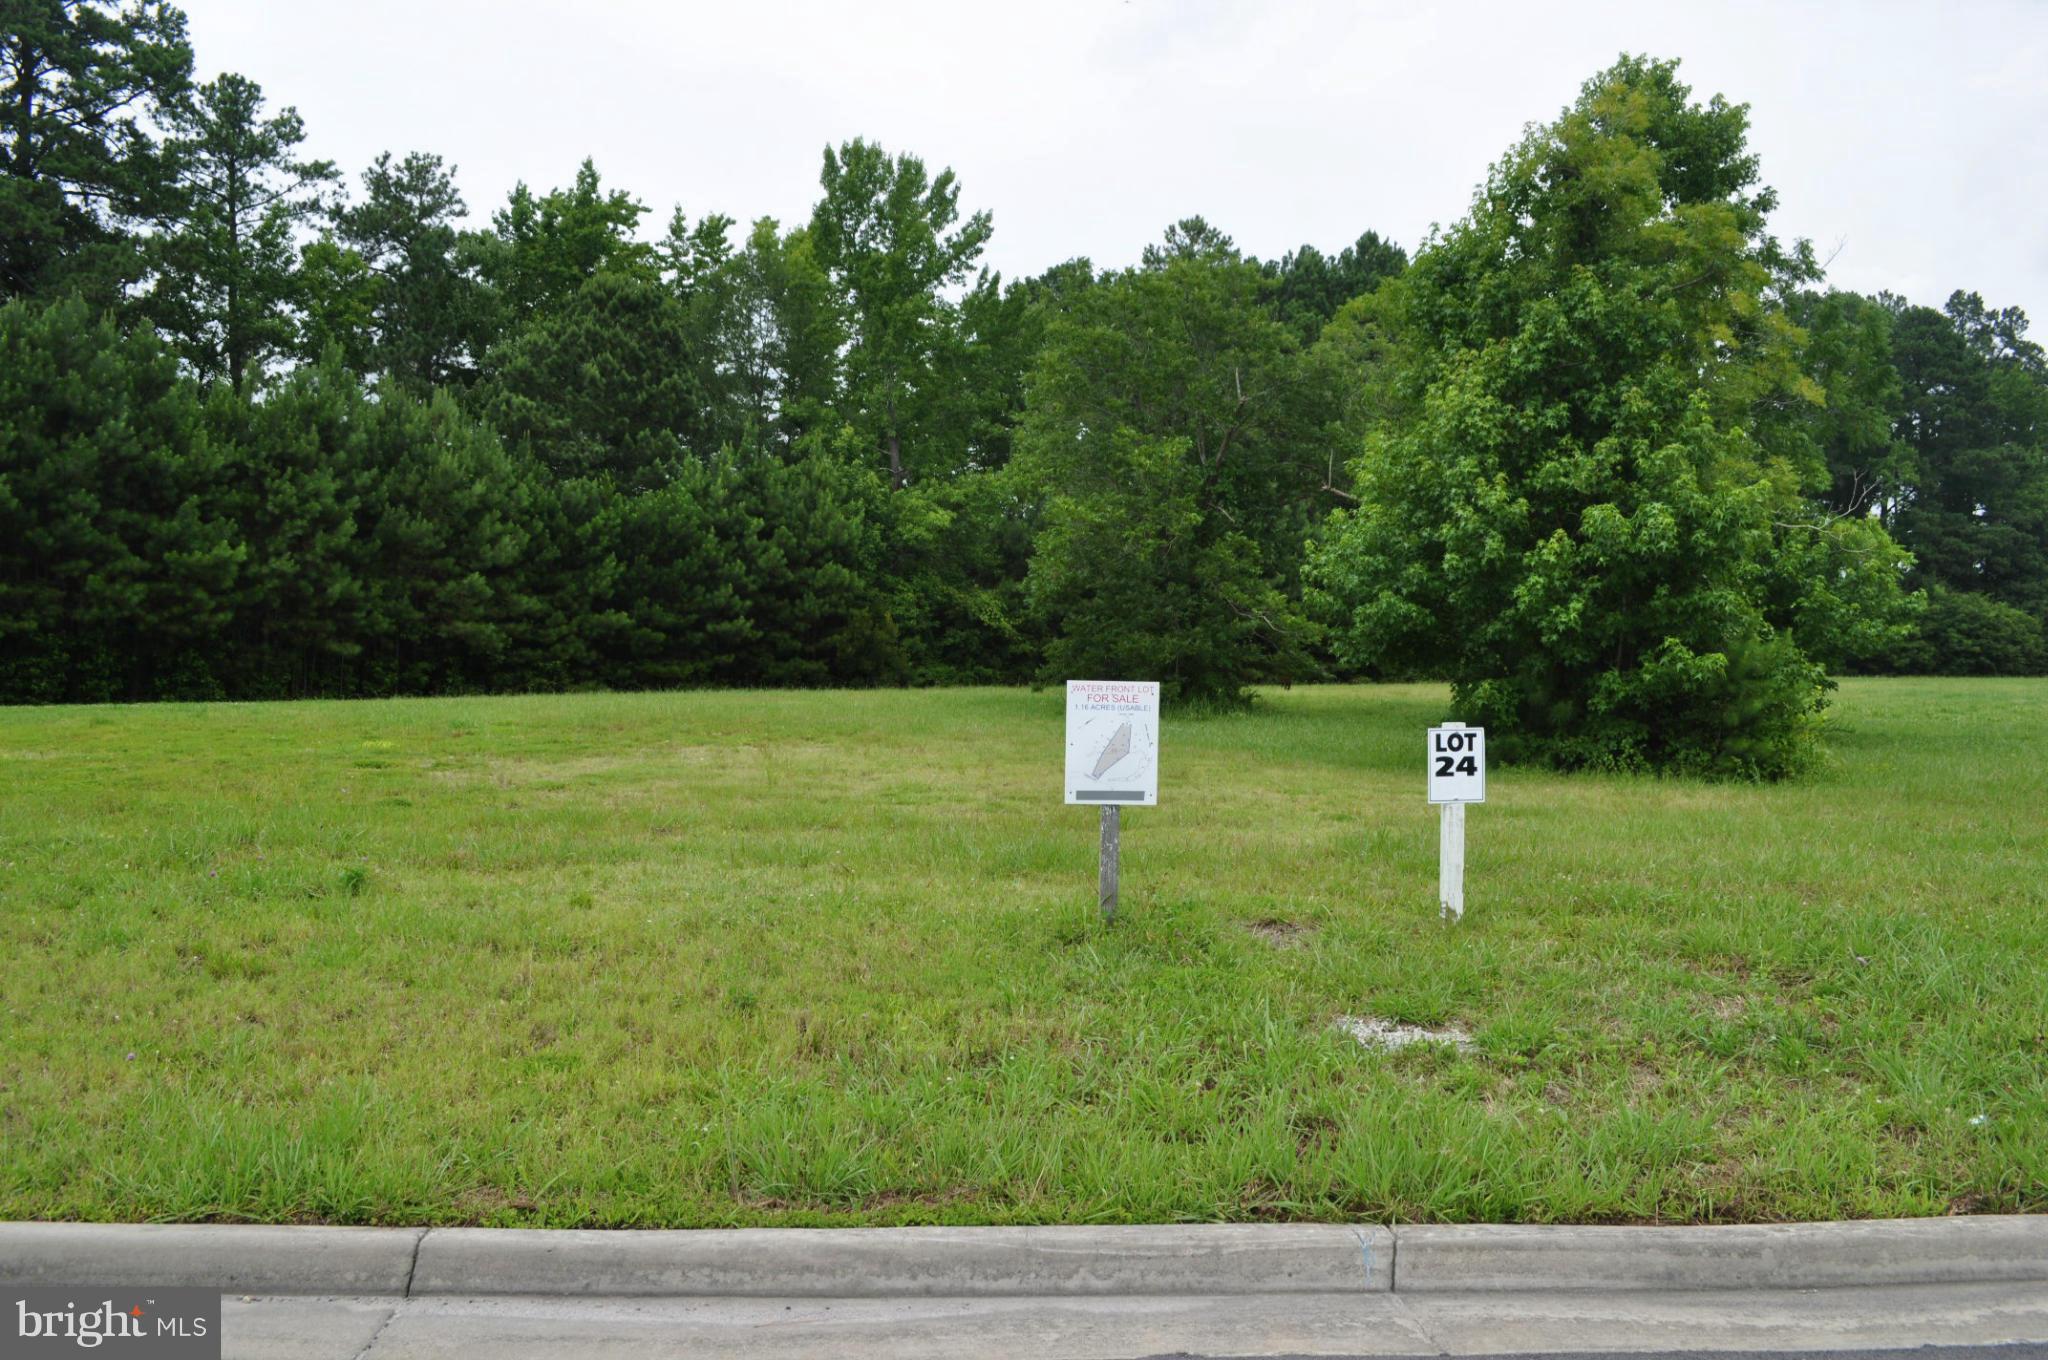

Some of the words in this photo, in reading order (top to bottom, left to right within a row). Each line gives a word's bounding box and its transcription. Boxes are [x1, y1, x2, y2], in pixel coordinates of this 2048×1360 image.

[1072, 684, 1103, 693] WATER
[1105, 685, 1135, 694] FRONT
[1138, 686, 1154, 694] LOT
[1087, 693, 1109, 703] FOR
[1112, 694, 1140, 704] SALE
[1090, 704, 1116, 712] ACRES
[1435, 732, 1477, 752] LOT
[1435, 756, 1478, 777] 24
